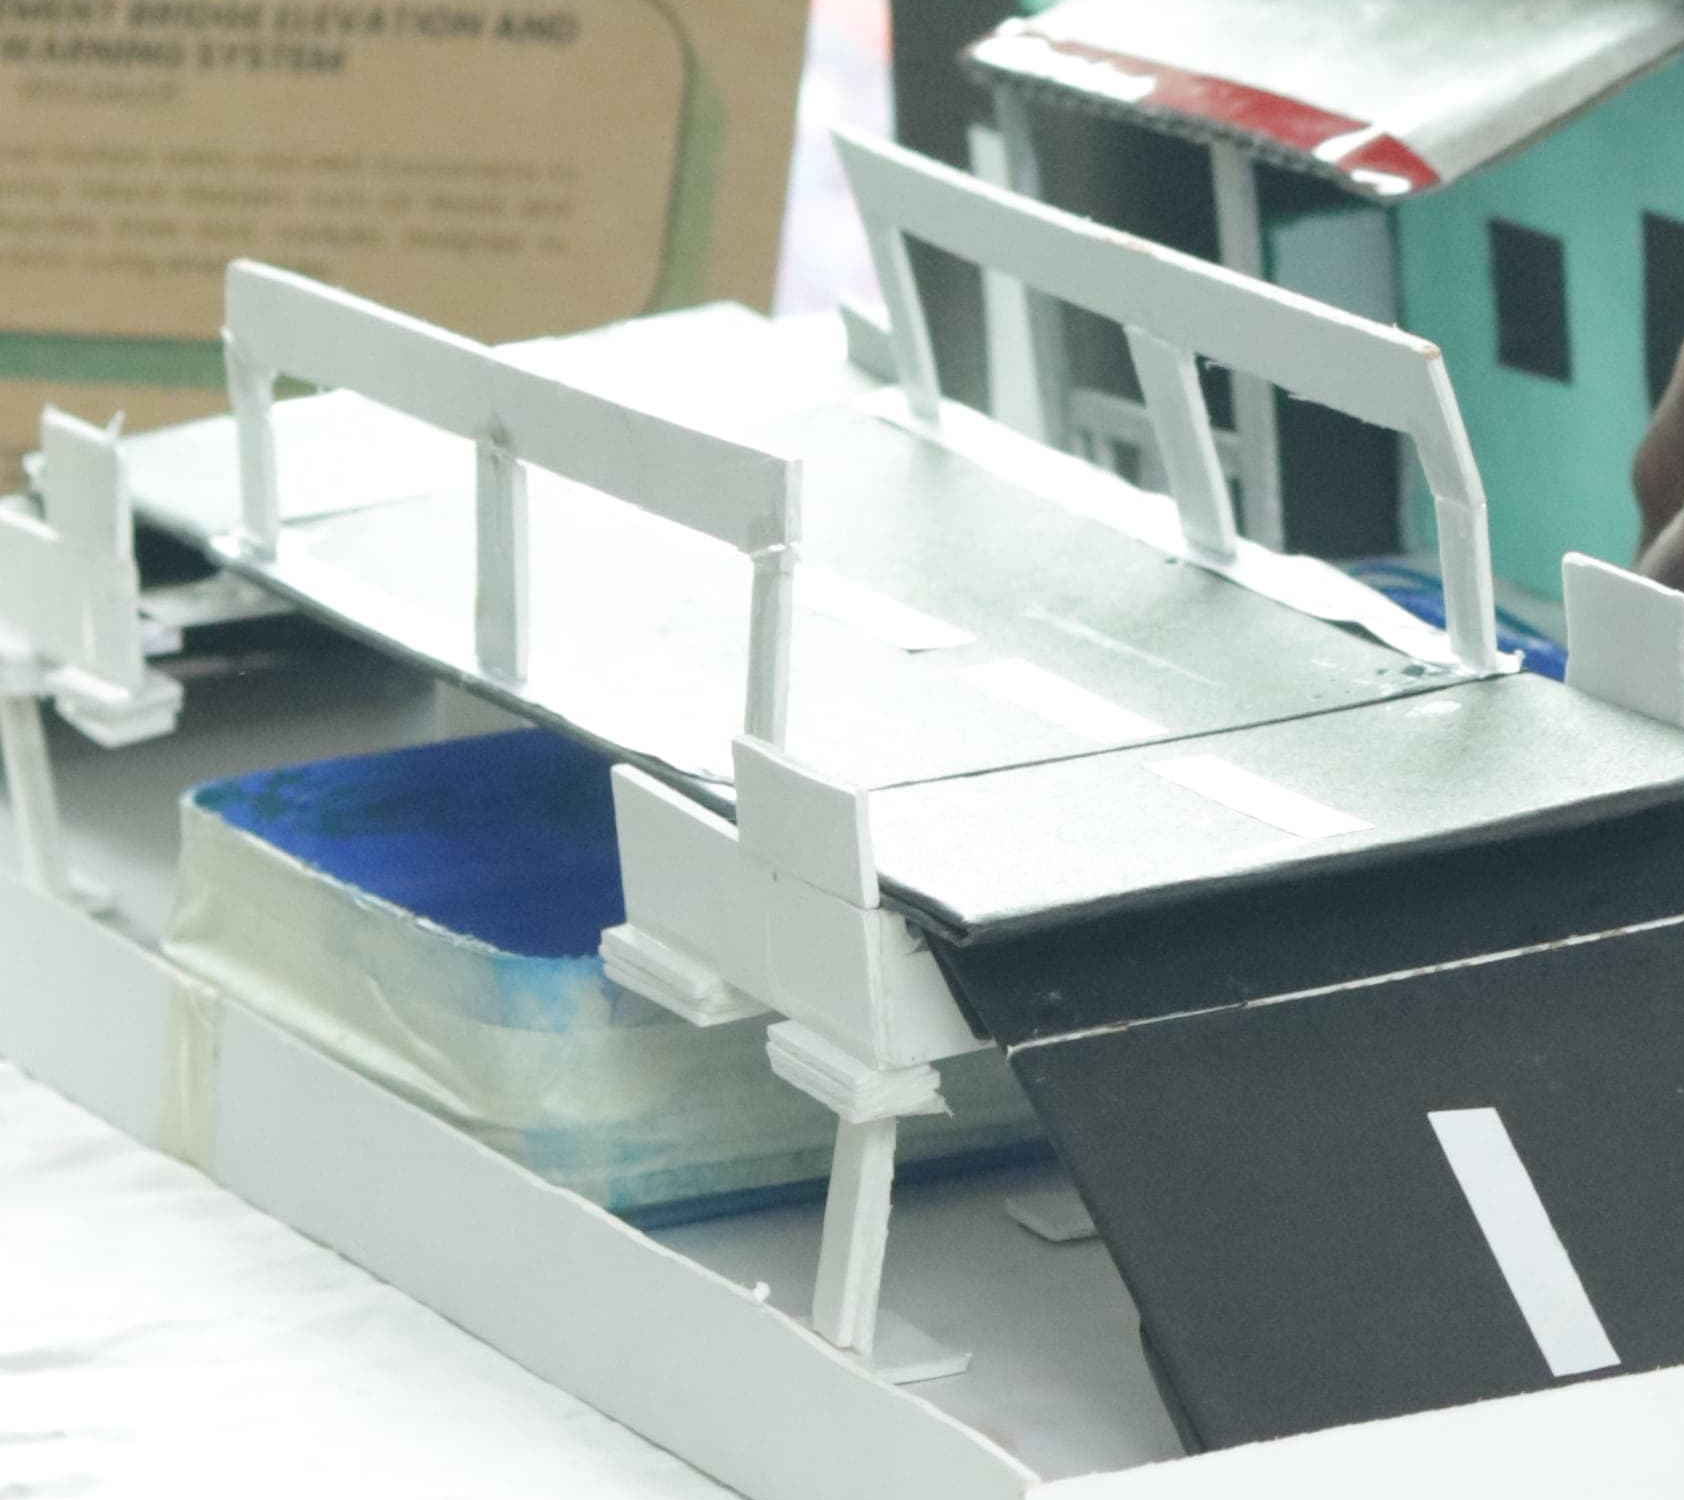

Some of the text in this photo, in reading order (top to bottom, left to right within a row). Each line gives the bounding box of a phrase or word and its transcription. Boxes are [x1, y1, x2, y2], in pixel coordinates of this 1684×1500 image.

[274, 3, 484, 39] ELEVATION
[494, 9, 581, 45] AND
[196, 41, 347, 74] SYSTEM
